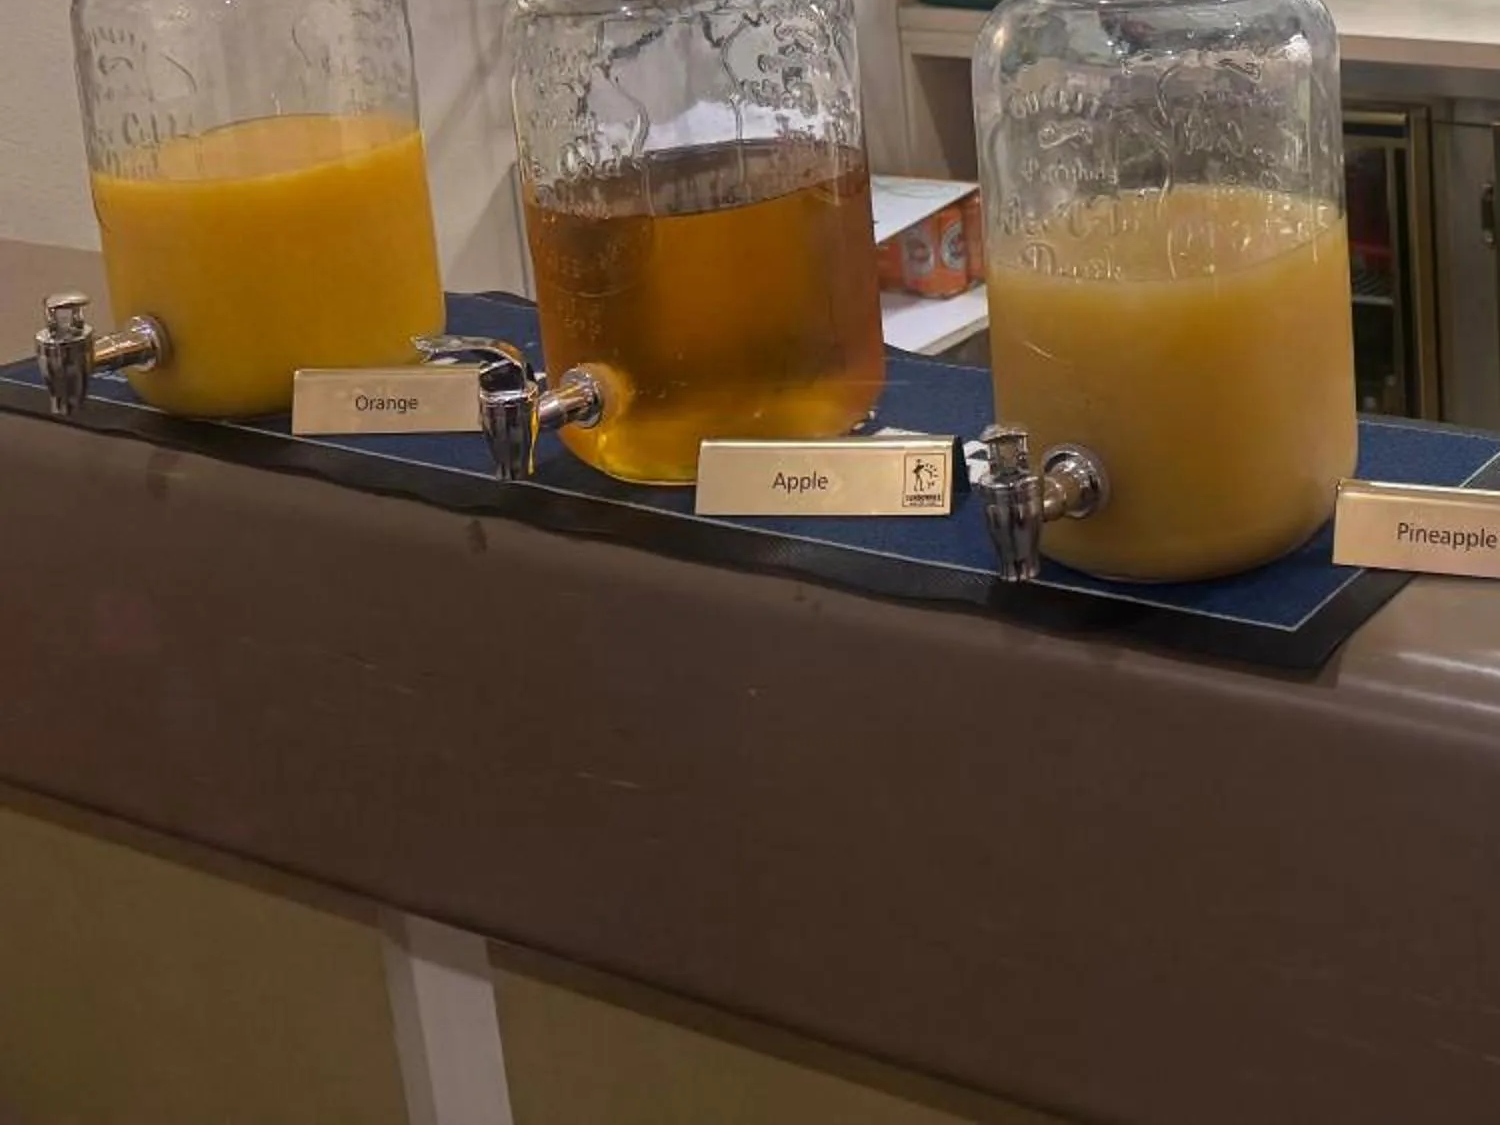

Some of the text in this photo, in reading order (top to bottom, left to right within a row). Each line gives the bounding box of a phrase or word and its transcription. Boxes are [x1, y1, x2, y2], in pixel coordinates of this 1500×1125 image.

[355, 395, 419, 414] Orange
[773, 471, 829, 493] Apple
[1396, 521, 1498, 552] Pineapple
